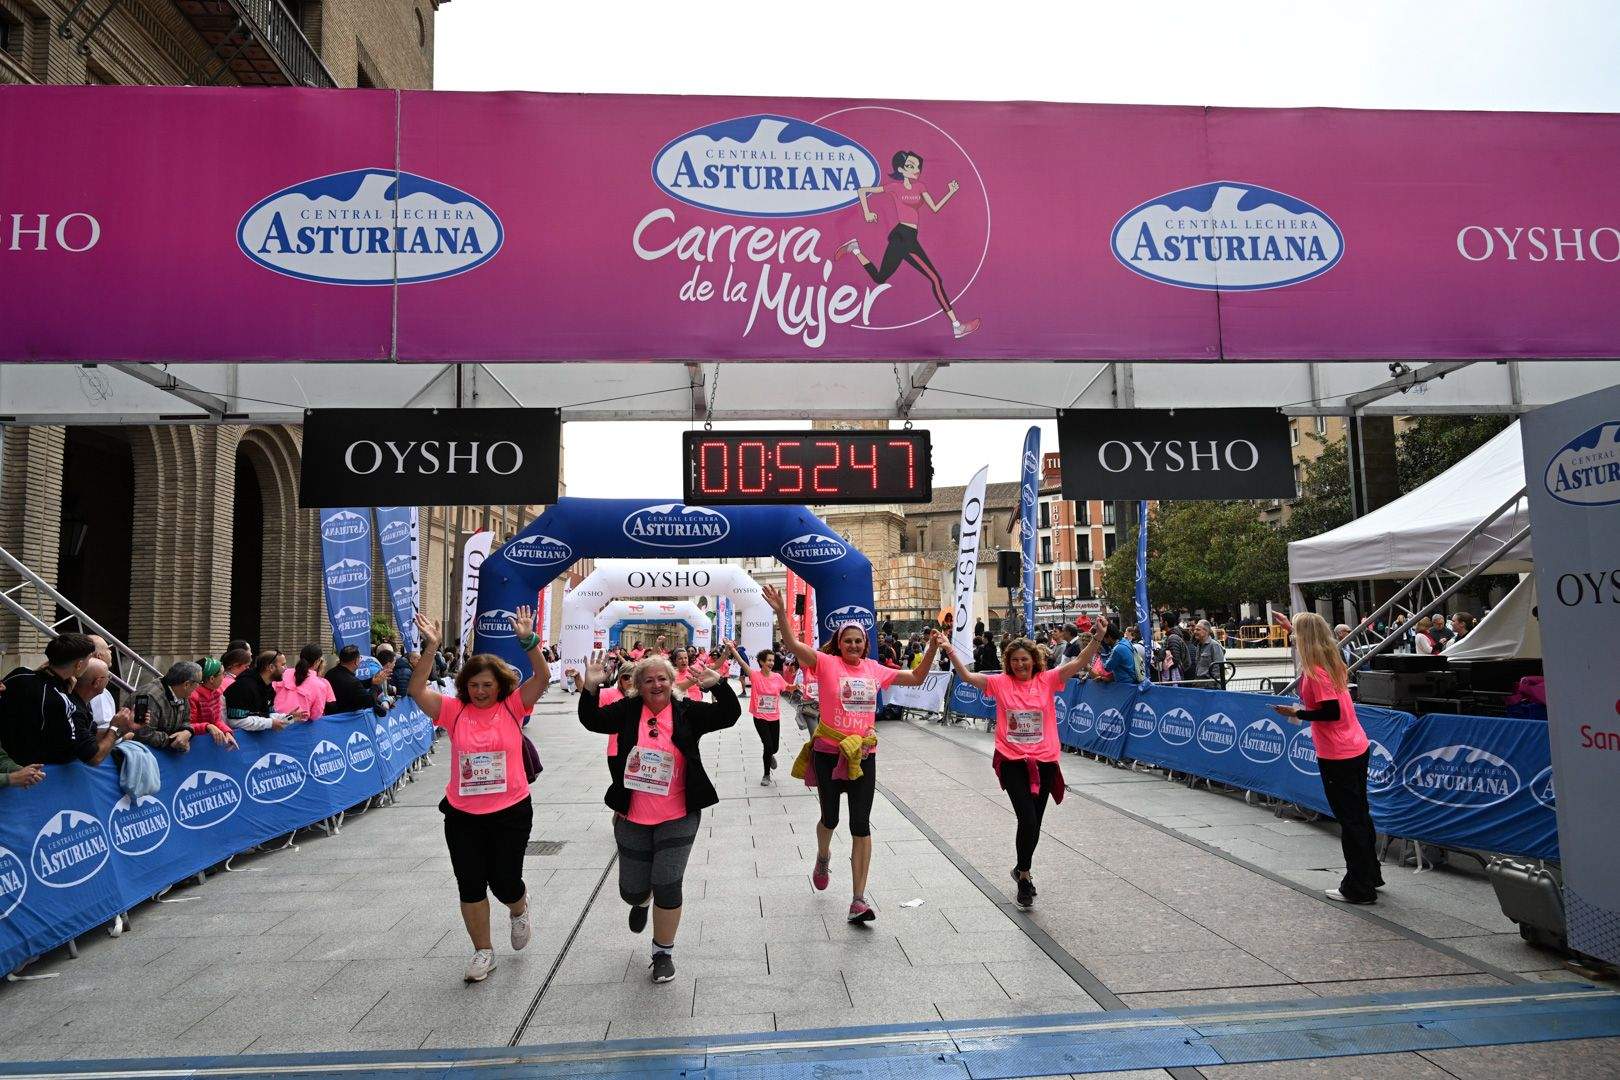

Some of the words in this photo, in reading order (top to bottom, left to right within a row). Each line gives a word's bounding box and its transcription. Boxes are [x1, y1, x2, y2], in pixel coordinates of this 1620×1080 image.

[670, 150, 861, 191] ASTURIANA
[706, 150, 777, 160] CENTRAL
[784, 151, 855, 161] LECHERA
[300, 209, 382, 220] CENTRAL
[391, 209, 475, 220] LECHERA
[1165, 219, 1238, 230] CENTRAL
[1245, 219, 1318, 230] LECHERA
[0, 212, 101, 252] HO
[257, 211, 484, 254] ASTURIANA
[632, 208, 822, 264] Carrera
[1130, 221, 1328, 262] ASTURIANA
[1456, 225, 1620, 263] OYSHO
[679, 265, 715, 301] de
[722, 265, 748, 303] la
[742, 259, 892, 349] Mujer
[344, 440, 524, 475] OYSHO
[1098, 439, 1259, 473] OYSHO
[1572, 452, 1615, 465] CENTRAL
[631, 517, 722, 536] ASTURIANA
[507, 546, 566, 559] ASTURIANA
[787, 547, 842, 558] ASTURIANA
[627, 570, 710, 588] OYSHO
[1199, 725, 1233, 745] ASTURIANA
[1241, 732, 1281, 754] ASTURIANA
[252, 770, 303, 797] ASTURIANA
[1409, 764, 1509, 796] ASTURIANA
[179, 789, 238, 820] ASTURIANA
[114, 813, 168, 846] ASTURIANA
[40, 834, 108, 879] ASTURIANA
